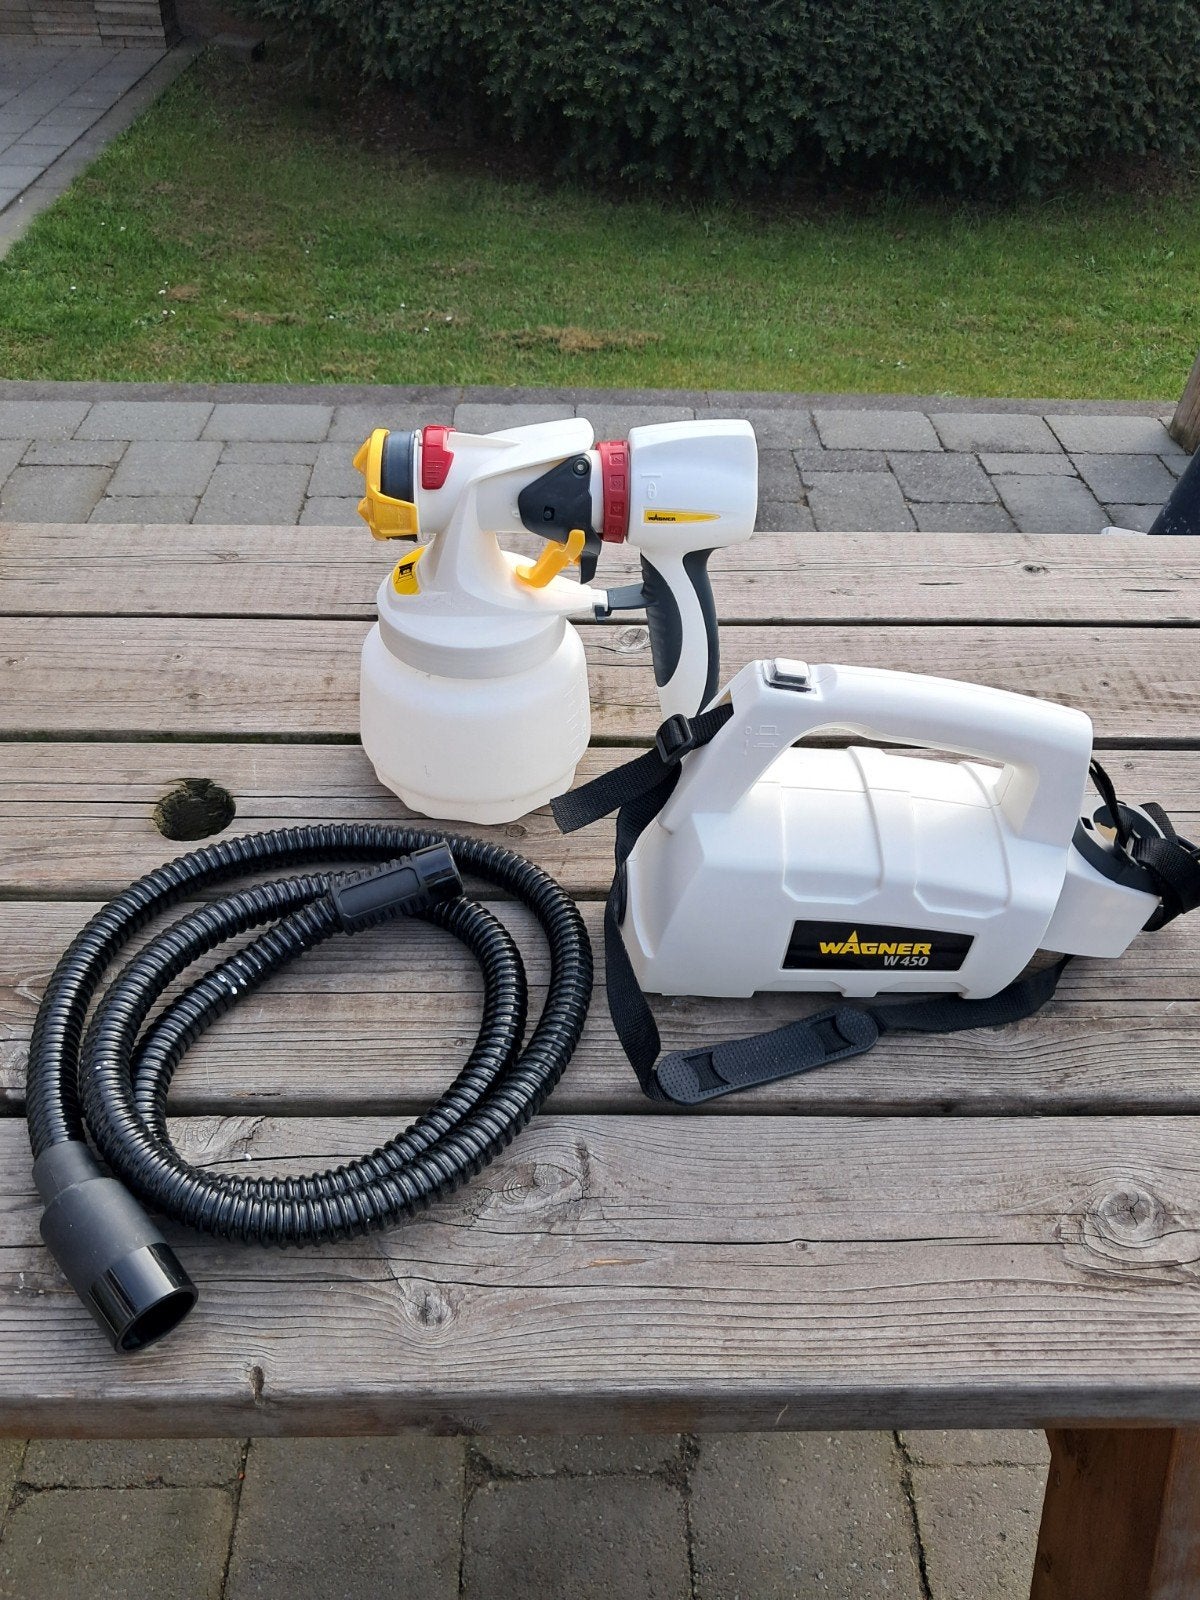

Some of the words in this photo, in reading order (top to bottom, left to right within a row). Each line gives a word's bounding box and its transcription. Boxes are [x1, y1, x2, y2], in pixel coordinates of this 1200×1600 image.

[819, 930, 932, 955] WAGNER
[884, 955, 898, 966] W
[900, 956, 929, 967] 450
